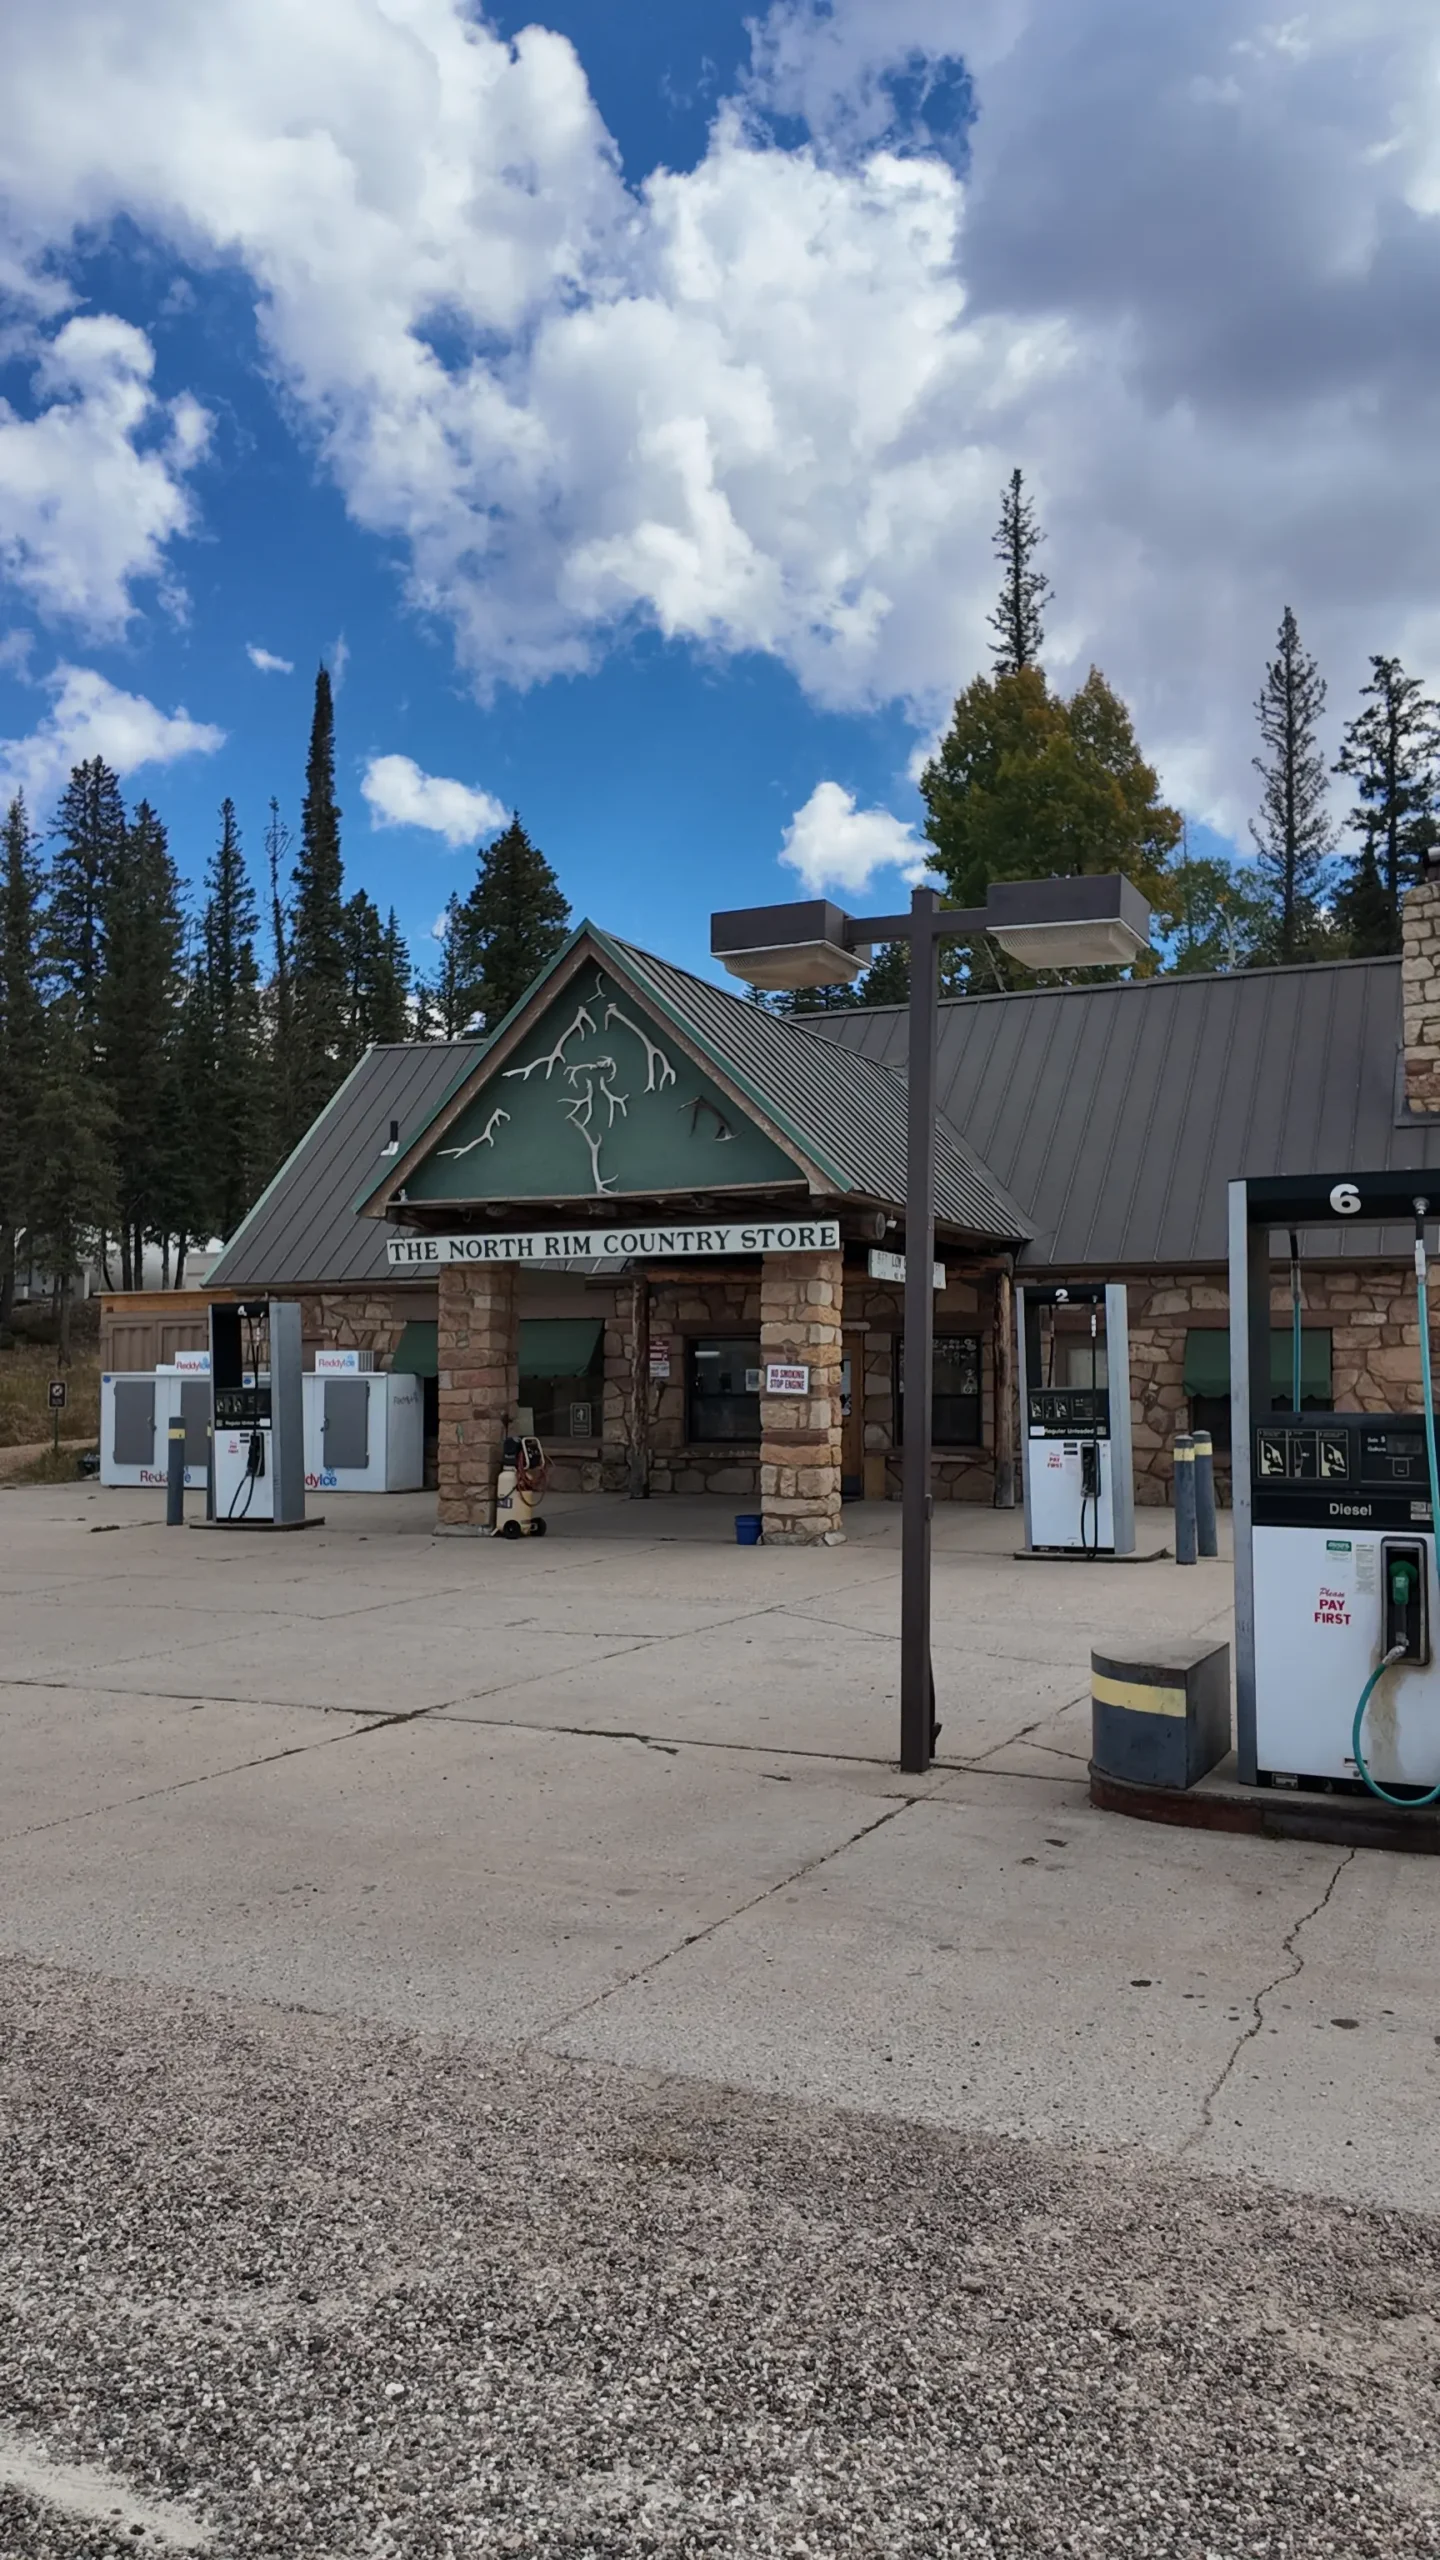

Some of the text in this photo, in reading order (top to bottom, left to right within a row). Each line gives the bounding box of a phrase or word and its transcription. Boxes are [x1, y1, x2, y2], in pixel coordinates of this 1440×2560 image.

[1329, 1183, 1362, 1215] 6
[389, 1226, 837, 1262] THE NORTH RIM COUNTRY STORE
[1055, 1288, 1069, 1302] 2
[771, 1369, 805, 1380] NO SMOKING
[769, 1379, 805, 1391] STOP ENGINE
[1328, 1502, 1373, 1516] Diesel
[1318, 1599, 1346, 1611] PAY
[1313, 1611, 1352, 1625] FIRST
